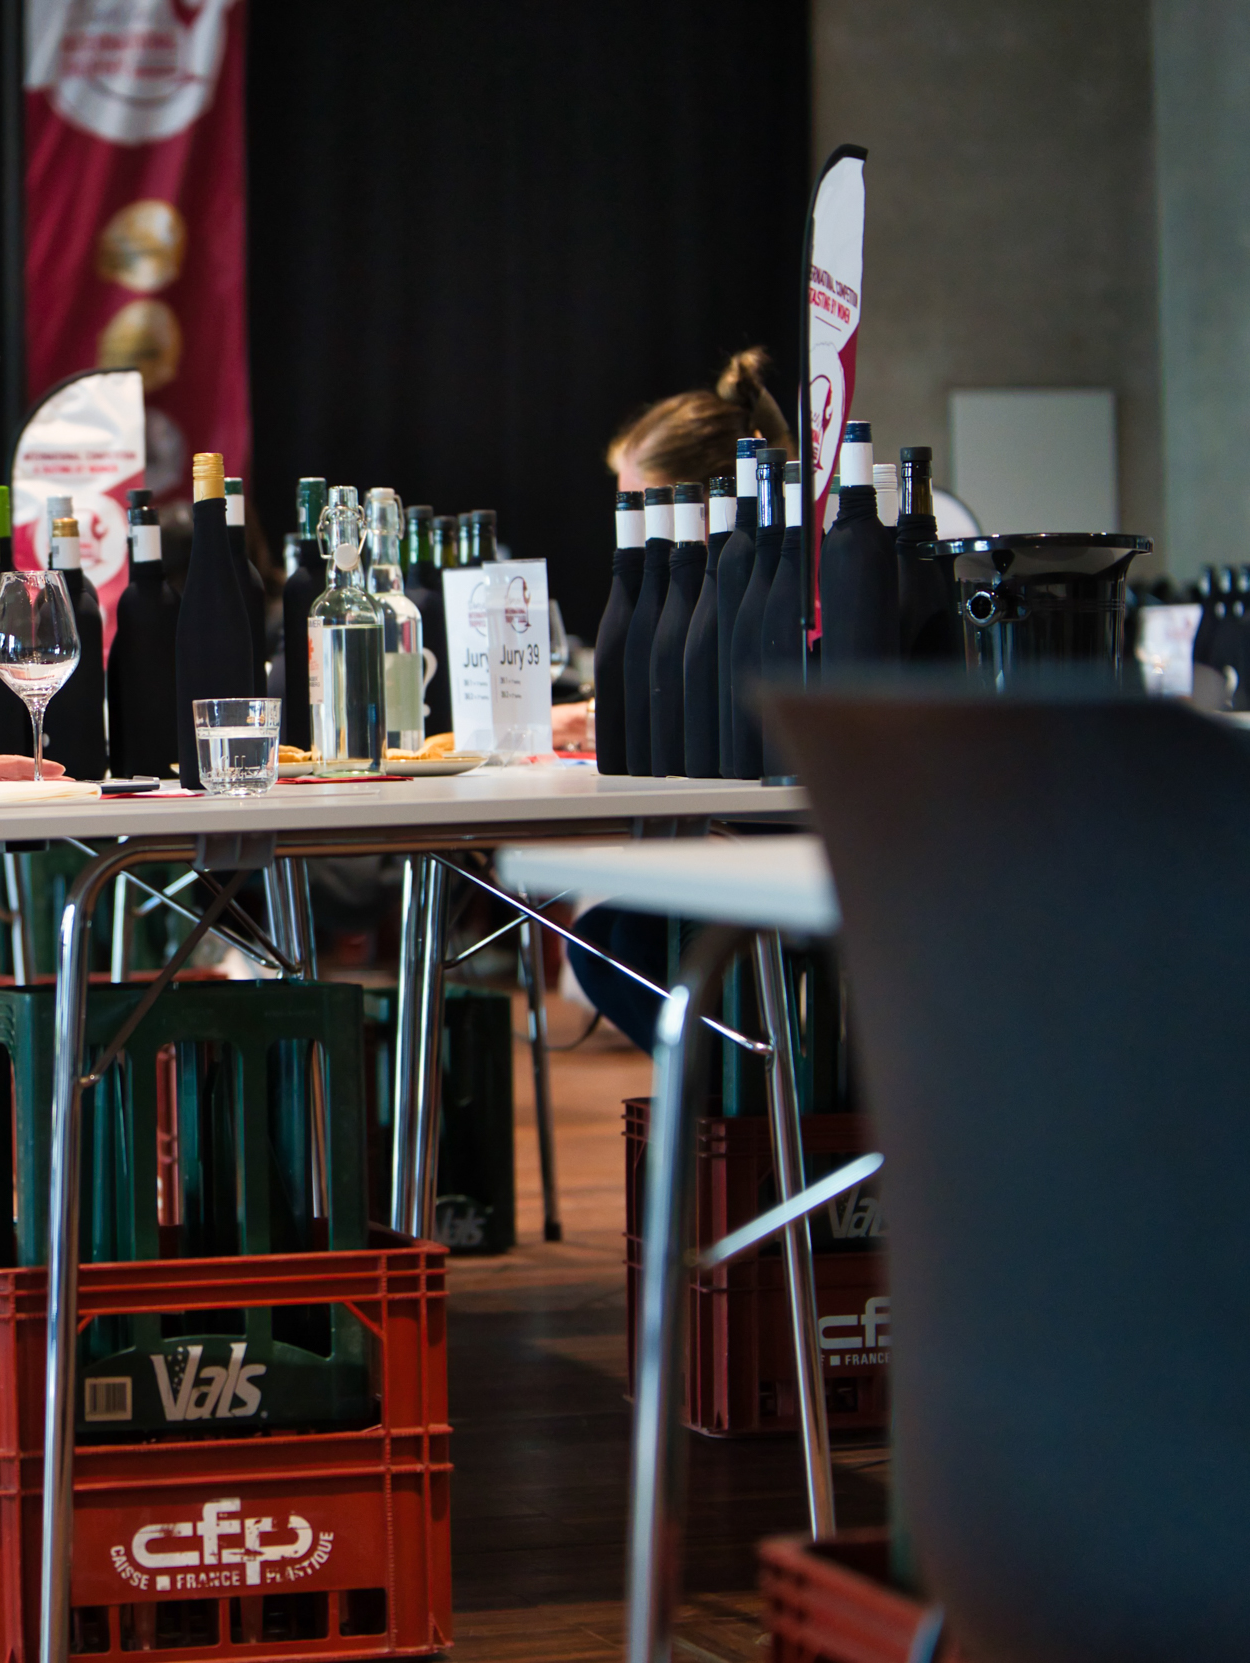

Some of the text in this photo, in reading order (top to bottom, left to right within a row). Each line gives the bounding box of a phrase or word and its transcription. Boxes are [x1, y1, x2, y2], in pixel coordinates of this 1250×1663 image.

[500, 643, 540, 671] Jury 39
[150, 1341, 267, 1421] Vals
[110, 1530, 335, 1590] CAISSE FRANCE PLASTIQUE
